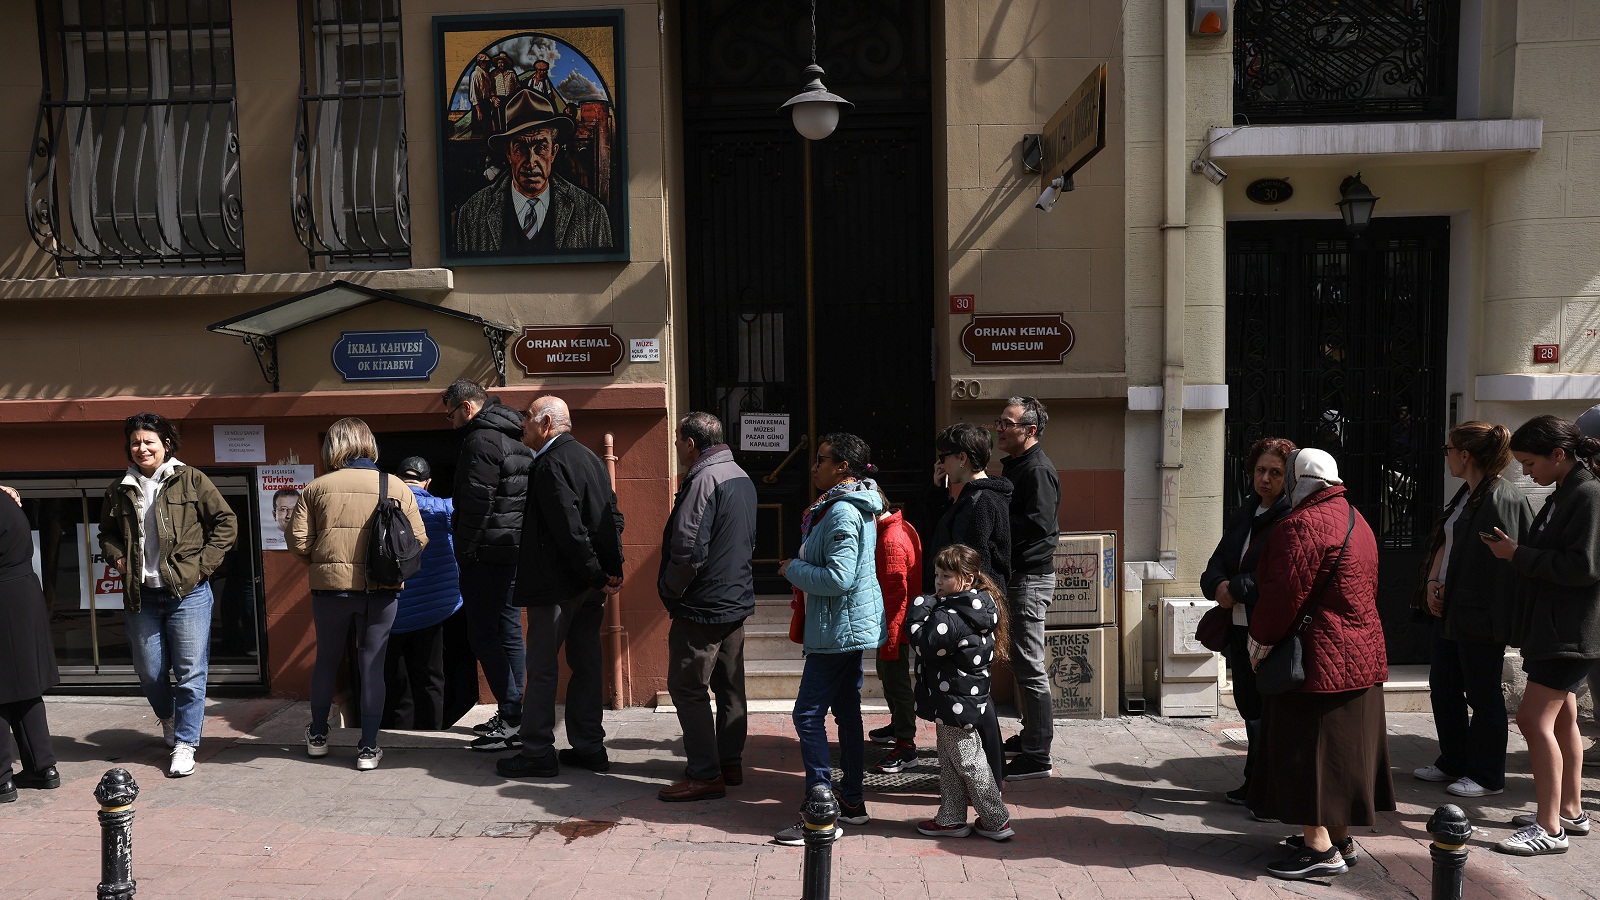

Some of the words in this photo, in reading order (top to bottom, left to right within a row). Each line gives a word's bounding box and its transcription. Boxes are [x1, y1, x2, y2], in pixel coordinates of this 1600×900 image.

[1264, 188, 1278, 201] 30
[956, 298, 968, 309] 30
[974, 327, 1016, 337] ORHAN
[1020, 326, 1061, 336] KEMAL
[347, 341, 377, 354] İKBAL
[380, 339, 423, 353] KAHVESİ
[526, 339, 567, 349] ORHAN
[570, 338, 611, 348] KEMAL
[991, 342, 1044, 351] MUSEUM
[546, 351, 591, 363] MÜZESİ
[1541, 348, 1553, 359] 28
[358, 361, 370, 370] OK
[372, 358, 414, 371] KİTABEVİ
[955, 379, 982, 398] 30
[261, 475, 294, 485] Türkiye
[1056, 565, 1084, 576] ugün
[1077, 592, 1090, 601] ol.
[1044, 633, 1090, 647] HERKES
[1051, 645, 1087, 657] SUSSA
